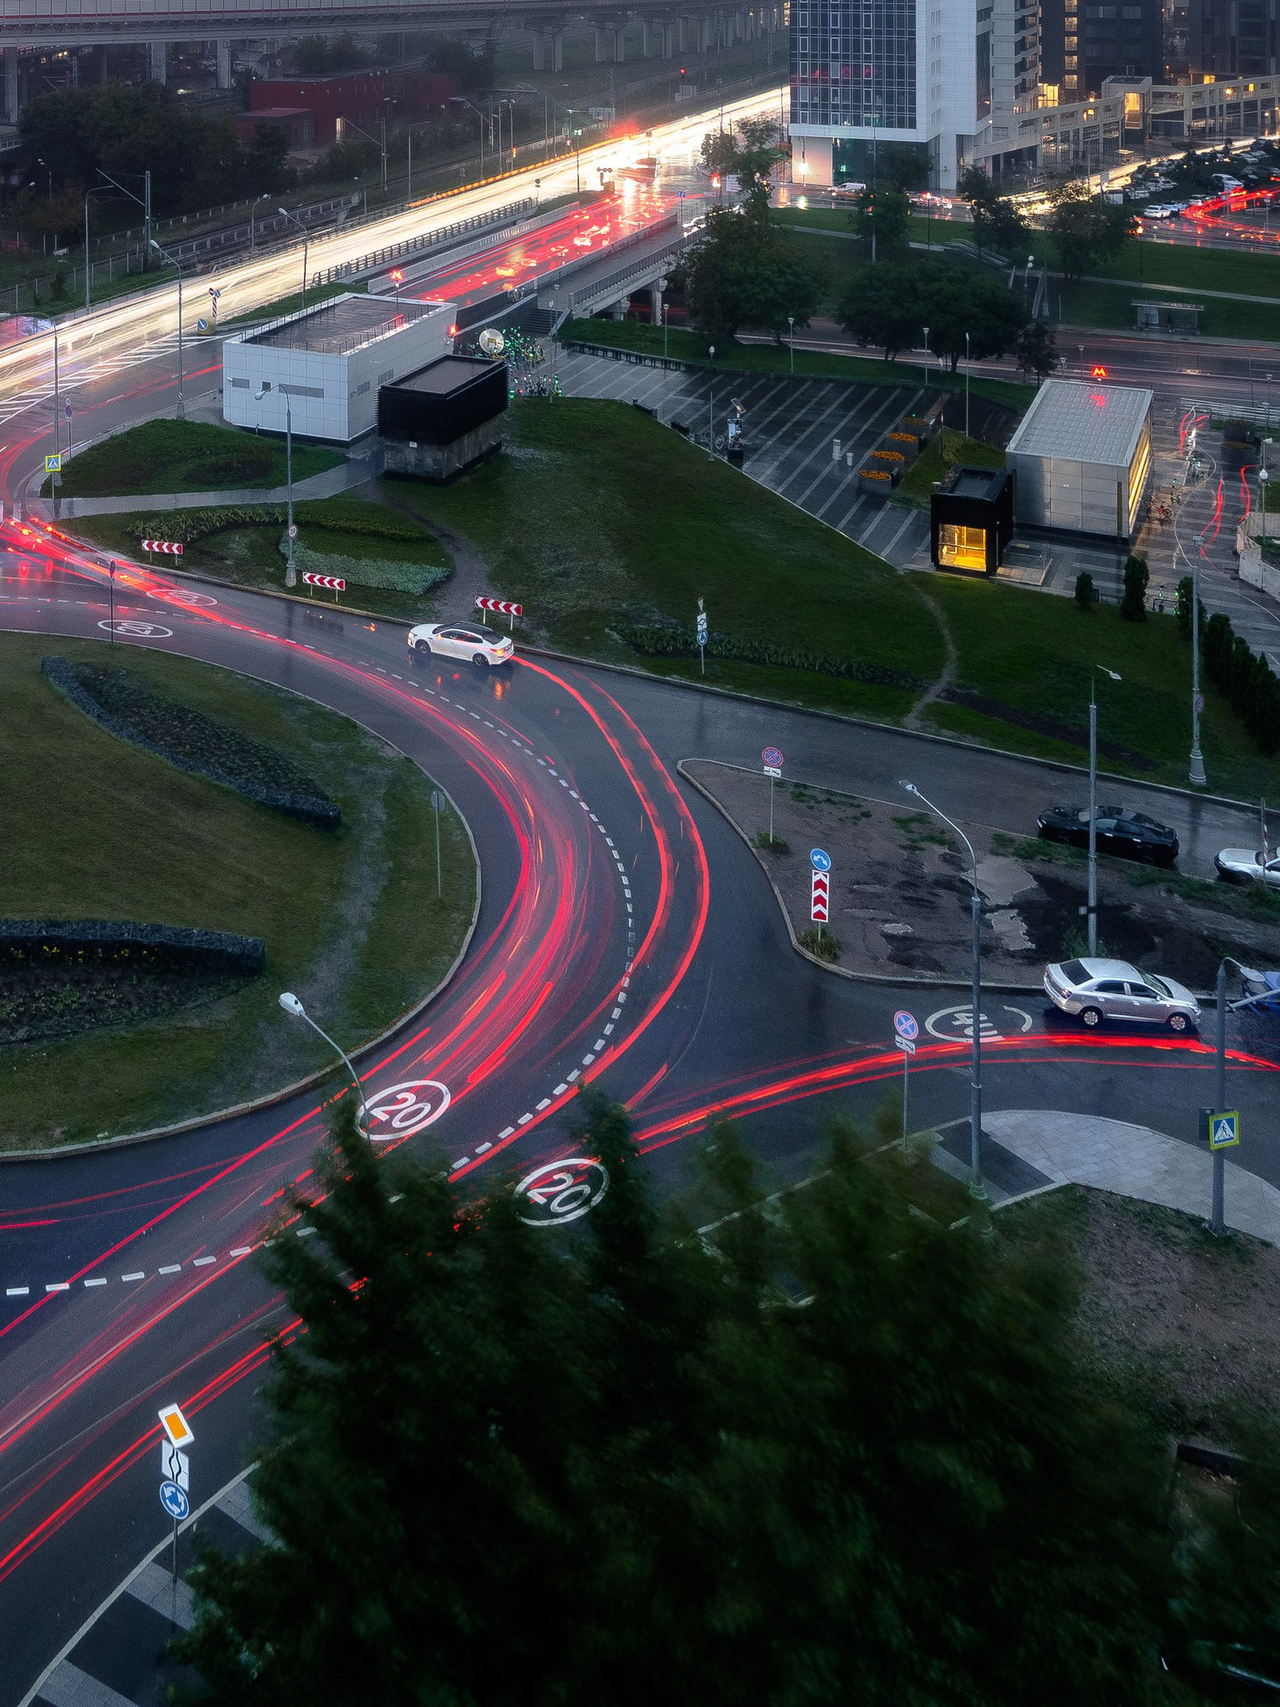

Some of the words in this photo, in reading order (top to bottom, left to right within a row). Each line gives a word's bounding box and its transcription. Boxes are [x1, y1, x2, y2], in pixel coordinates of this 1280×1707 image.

[117, 622, 154, 635] 20
[370, 1092, 431, 1129] 20
[527, 1172, 591, 1213] 20
